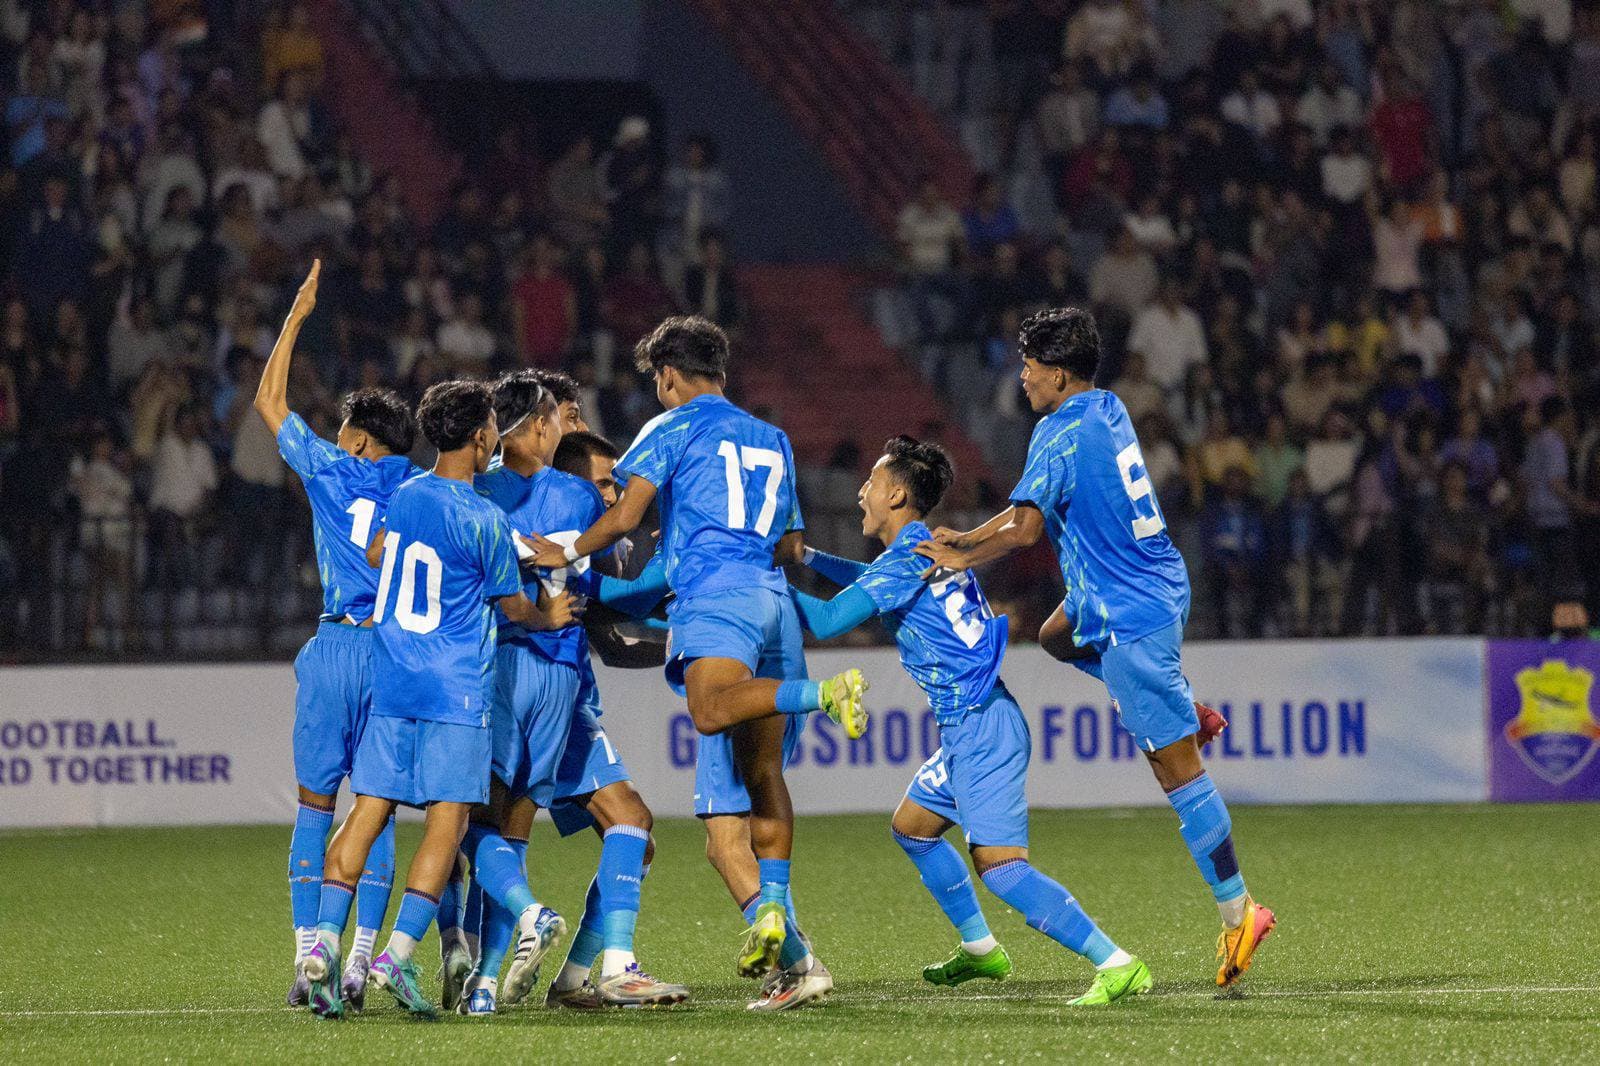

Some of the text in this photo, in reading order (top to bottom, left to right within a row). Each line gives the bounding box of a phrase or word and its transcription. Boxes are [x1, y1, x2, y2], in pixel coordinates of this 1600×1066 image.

[345, 497, 387, 550] 1
[717, 439, 784, 538] 17
[1115, 441, 1164, 541] 5
[372, 530, 443, 635] 10
[45, 754, 232, 785] TOGETHER
